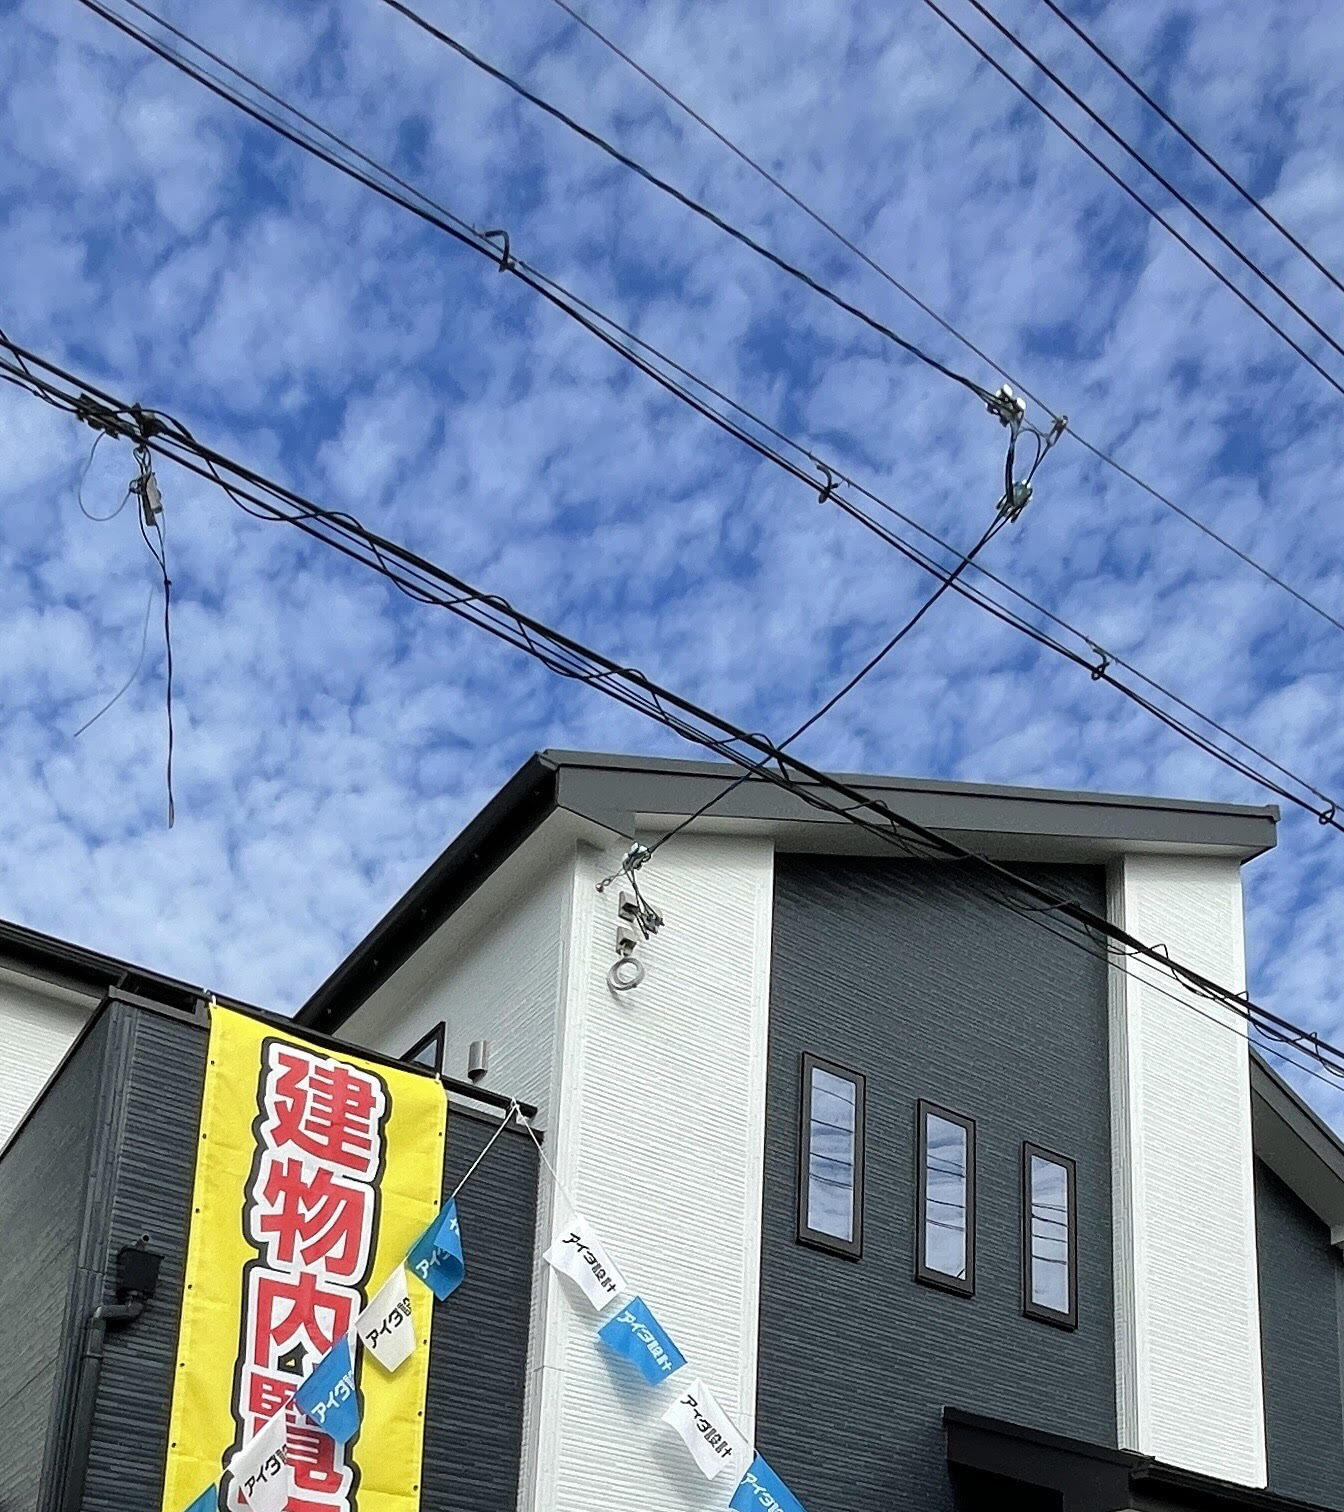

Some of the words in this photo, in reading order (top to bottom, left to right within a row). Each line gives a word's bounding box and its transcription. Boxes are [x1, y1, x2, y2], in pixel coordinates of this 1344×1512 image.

[562, 1231, 617, 1294] アイダ設計
[616, 1309, 674, 1373] アイダ設計
[680, 1394, 733, 1459] アイダ設計
